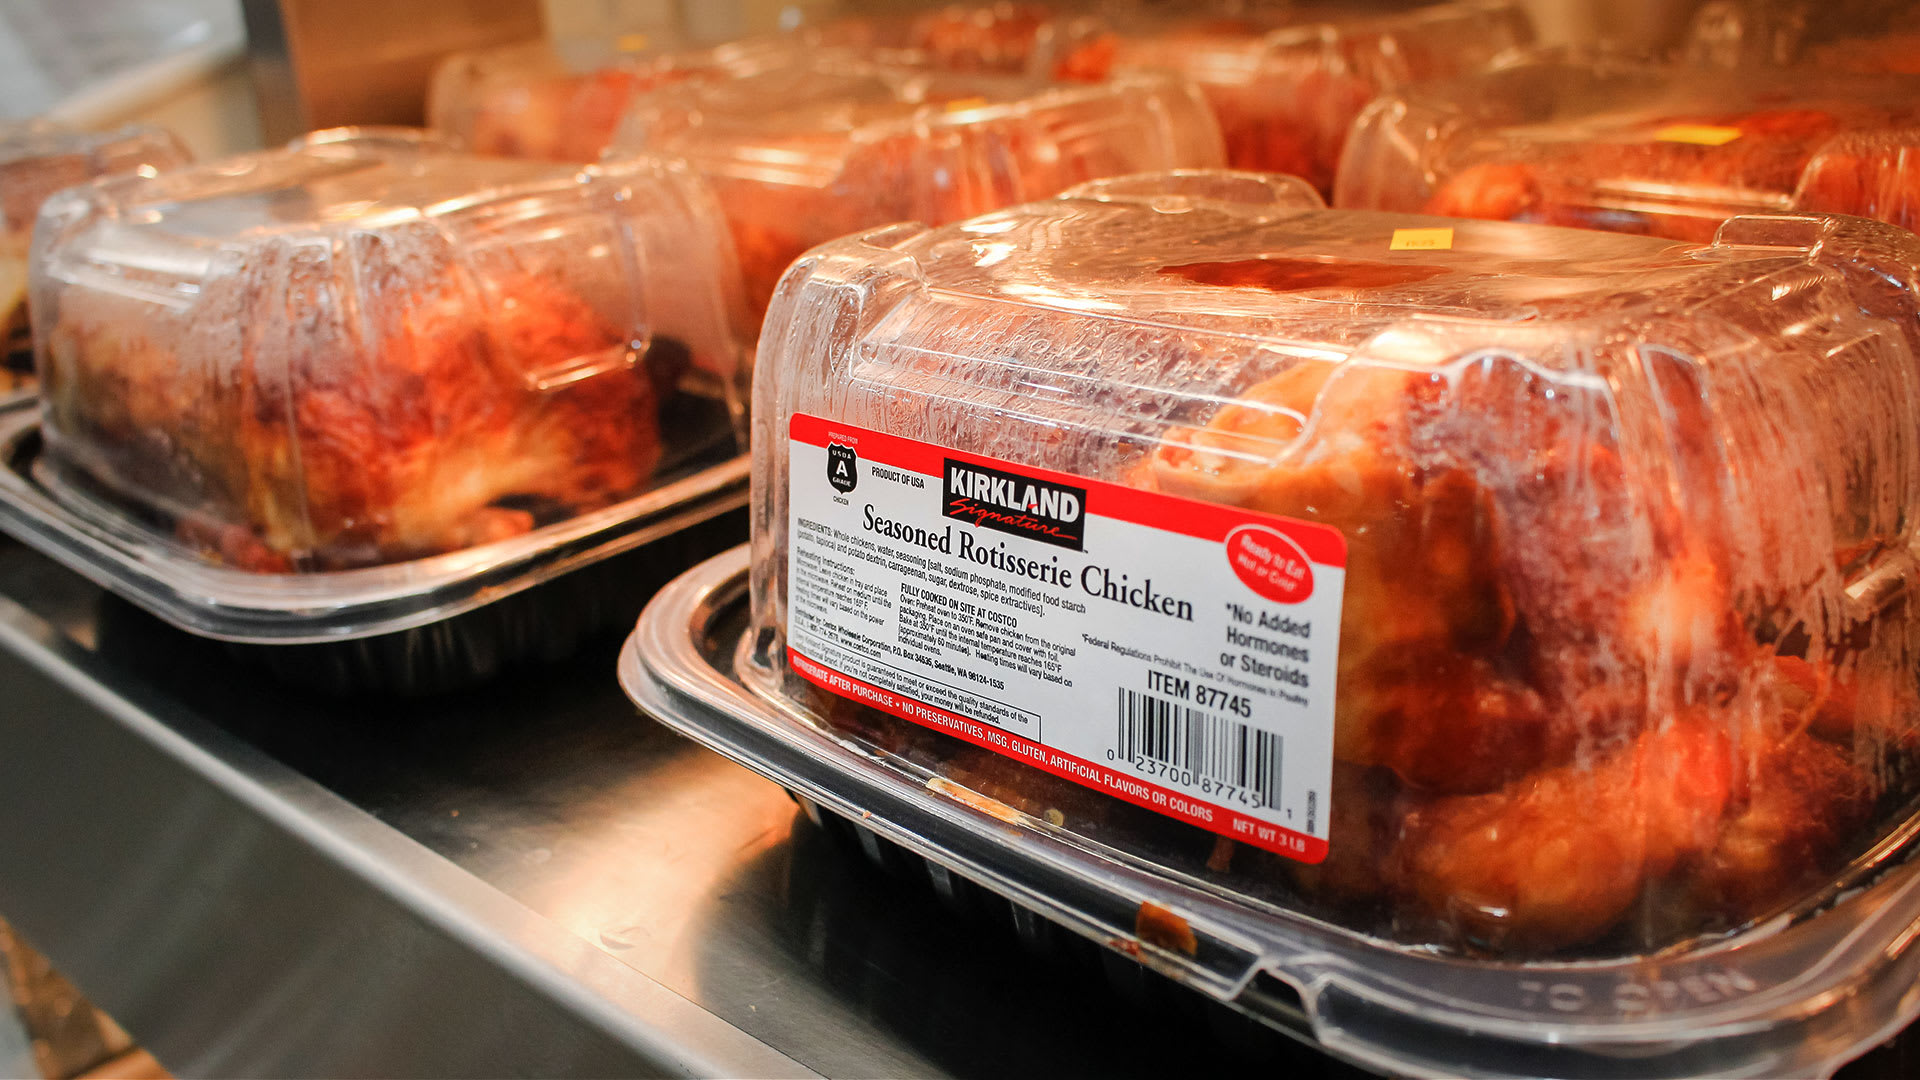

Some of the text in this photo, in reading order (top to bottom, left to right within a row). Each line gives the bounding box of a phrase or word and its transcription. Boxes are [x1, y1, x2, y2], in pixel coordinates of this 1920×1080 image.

[832, 450, 851, 459] USDA
[836, 460, 848, 477] A
[832, 477, 850, 486] GRADE
[872, 466, 924, 489] PRODUCT OF USA
[950, 467, 1079, 523] KIRKLAND
[833, 496, 849, 505] CHICKEN
[949, 498, 1078, 540] Signature
[834, 530, 849, 542] Whole
[851, 536, 876, 552] chickens,
[878, 545, 895, 559] water,
[896, 551, 926, 569] seasoning
[944, 566, 968, 580] sodium
[970, 573, 1007, 593] phosphate,
[1009, 585, 1041, 601] modified
[1043, 593, 1059, 607] food
[1062, 600, 1086, 613] starch
[837, 544, 847, 554] and
[848, 548, 865, 560] potato
[866, 553, 887, 568] dextrin,
[888, 561, 927, 581] carrageenan,
[928, 574, 947, 588] sugar,
[949, 579, 979, 597] dextrose,
[980, 590, 999, 602] spice
[863, 504, 1192, 620] Seasoned Rotisserie Chicken
[1241, 534, 1305, 580] Ready to Eat
[864, 584, 887, 597] and place
[883, 599, 891, 608] the
[901, 583, 1017, 628] FULLY COOKED ON SITE AT COSTCO
[869, 615, 884, 625] power
[916, 599, 936, 613] Preheat
[937, 608, 950, 617] oven
[951, 611, 957, 620] to
[975, 618, 999, 633] Remove
[1000, 627, 1023, 640] chicken
[1025, 634, 1039, 645] from
[1041, 639, 1051, 652] the
[1052, 644, 1076, 656] original
[929, 613, 943, 626] Place
[961, 626, 975, 636] oven
[976, 631, 988, 640] safe
[989, 635, 1001, 644] pan
[1002, 639, 1013, 648] and
[1015, 643, 1032, 653] cover
[1033, 648, 1046, 658] with
[1048, 651, 1059, 662] foil.
[1259, 612, 1310, 638] Added
[841, 639, 881, 658] www.costco.com
[898, 633, 941, 656] individual ovens.
[899, 613, 912, 625] Bake
[913, 618, 918, 628] at
[936, 628, 947, 637] until
[948, 631, 957, 641] the
[959, 634, 980, 648] internal
[981, 641, 1017, 659] temperature
[1018, 654, 1042, 667] reaches
[1111, 642, 1151, 661] Regulations
[1154, 655, 1181, 669] Prohibit
[1184, 663, 1197, 674] The
[1227, 627, 1308, 662] Hormones
[862, 635, 892, 654] Corporation,
[893, 646, 902, 657] P.O.
[903, 649, 914, 660] Box
[934, 660, 956, 676] Seattle,
[957, 667, 967, 678] WA
[968, 671, 1004, 690] 98124-1535
[938, 637, 945, 646] 60
[976, 649, 998, 666] Heating
[999, 657, 1016, 670] times
[1017, 664, 1027, 673] will
[1028, 667, 1042, 680] vary
[1043, 670, 1063, 684] based
[1220, 653, 1308, 687] or Steroids
[921, 692, 933, 704] your
[934, 697, 954, 712] money
[953, 702, 964, 716] will
[965, 705, 972, 717] be
[973, 707, 1000, 724] refunded.
[926, 684, 947, 696] exceed
[948, 690, 957, 700] the
[958, 695, 978, 708] quality
[979, 702, 1009, 717] standards
[1018, 714, 1028, 724] the
[1148, 670, 1251, 717] ITEM 87745
[829, 675, 851, 691] AFTER
[853, 684, 892, 707] PURCHASE
[902, 702, 914, 714] NO
[916, 707, 985, 740] PRESERVATIVES,
[1012, 740, 1048, 764] GLUTEN,
[1104, 774, 1149, 799] FLAVORS
[1152, 791, 1166, 806] OR
[1170, 797, 1212, 821] COLORS
[1107, 749, 1115, 761] 0
[1136, 756, 1191, 787] 23700
[1202, 778, 1261, 810] 87745
[1233, 818, 1305, 852] NET WT 3 LB
